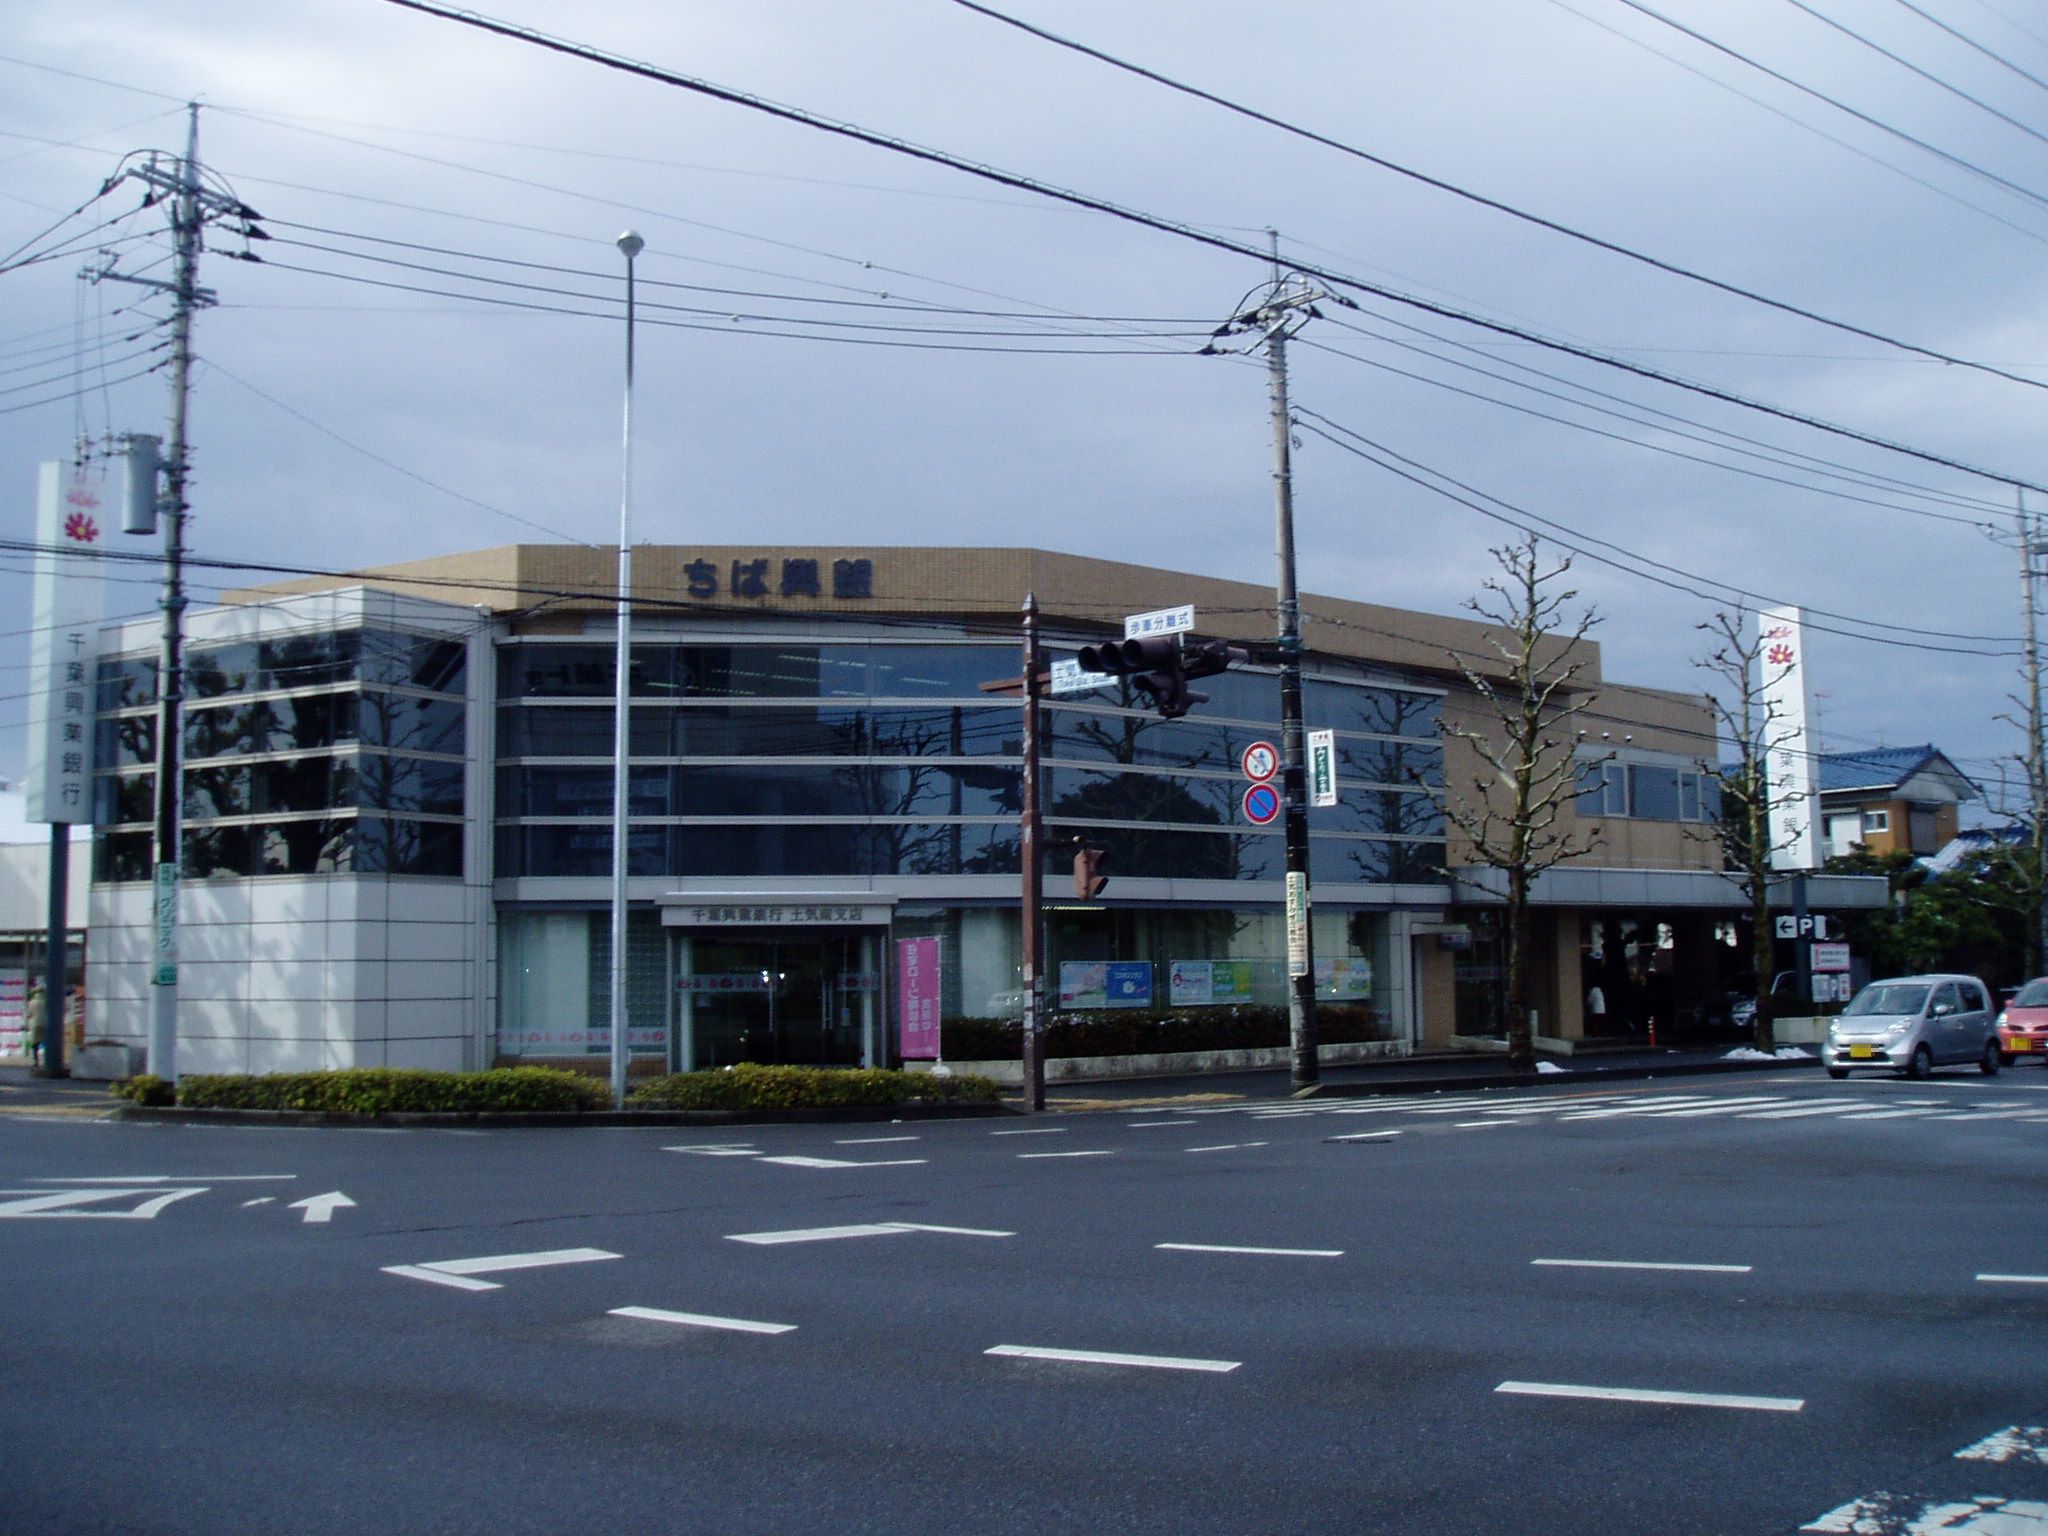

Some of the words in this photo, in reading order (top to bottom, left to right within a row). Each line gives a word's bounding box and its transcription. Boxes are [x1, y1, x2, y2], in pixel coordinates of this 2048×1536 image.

[62, 633, 86, 805] 千葉興業銀行
[691, 907, 783, 922] 千葉興業銀行
[1800, 918, 1813, 935] P
